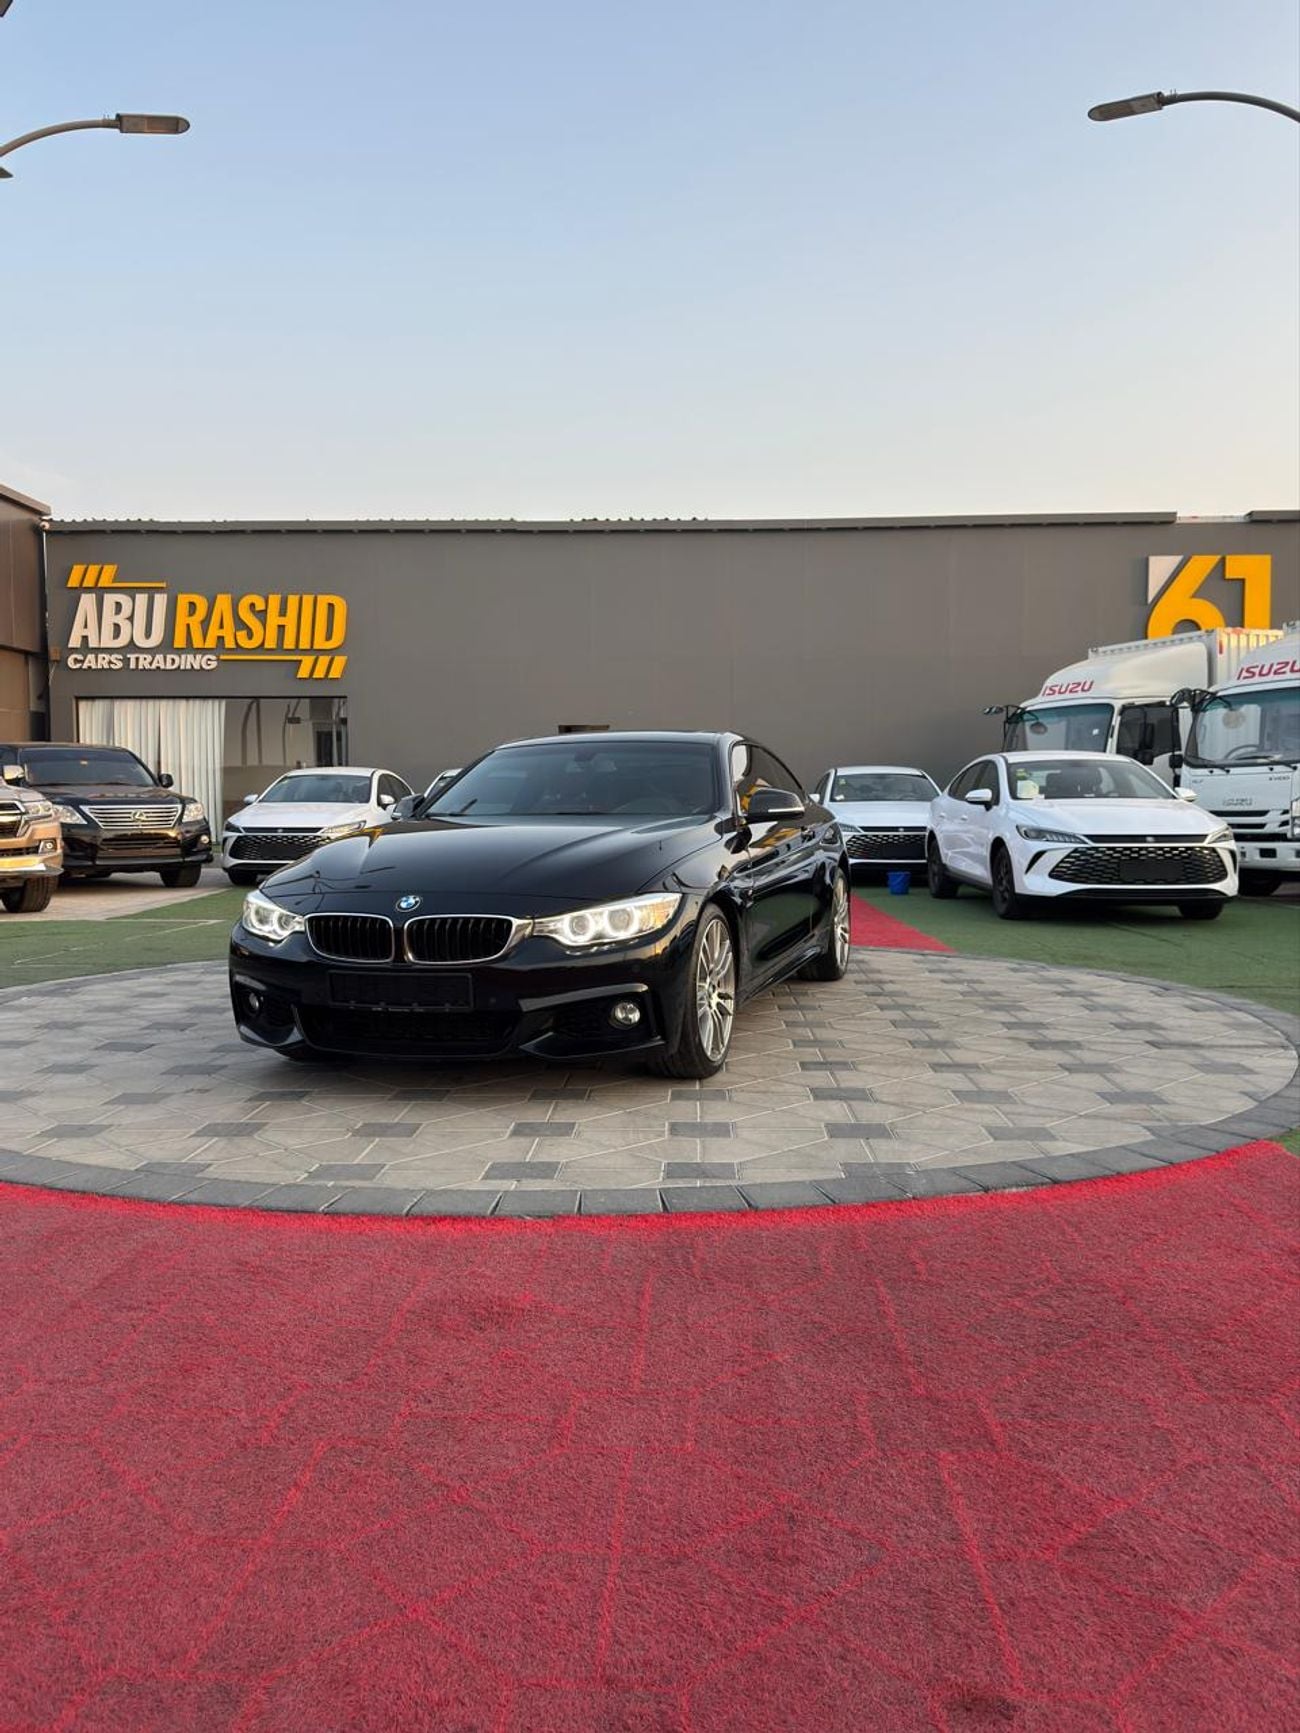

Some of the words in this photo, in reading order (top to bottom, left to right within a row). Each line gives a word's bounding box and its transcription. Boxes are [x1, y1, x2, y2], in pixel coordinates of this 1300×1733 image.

[1147, 555, 1271, 640] 61
[67, 593, 168, 649] ABU
[173, 594, 348, 650] RASHID
[67, 653, 123, 670] CARS
[127, 653, 219, 670] TRADING
[1042, 680, 1094, 697] ISUZU
